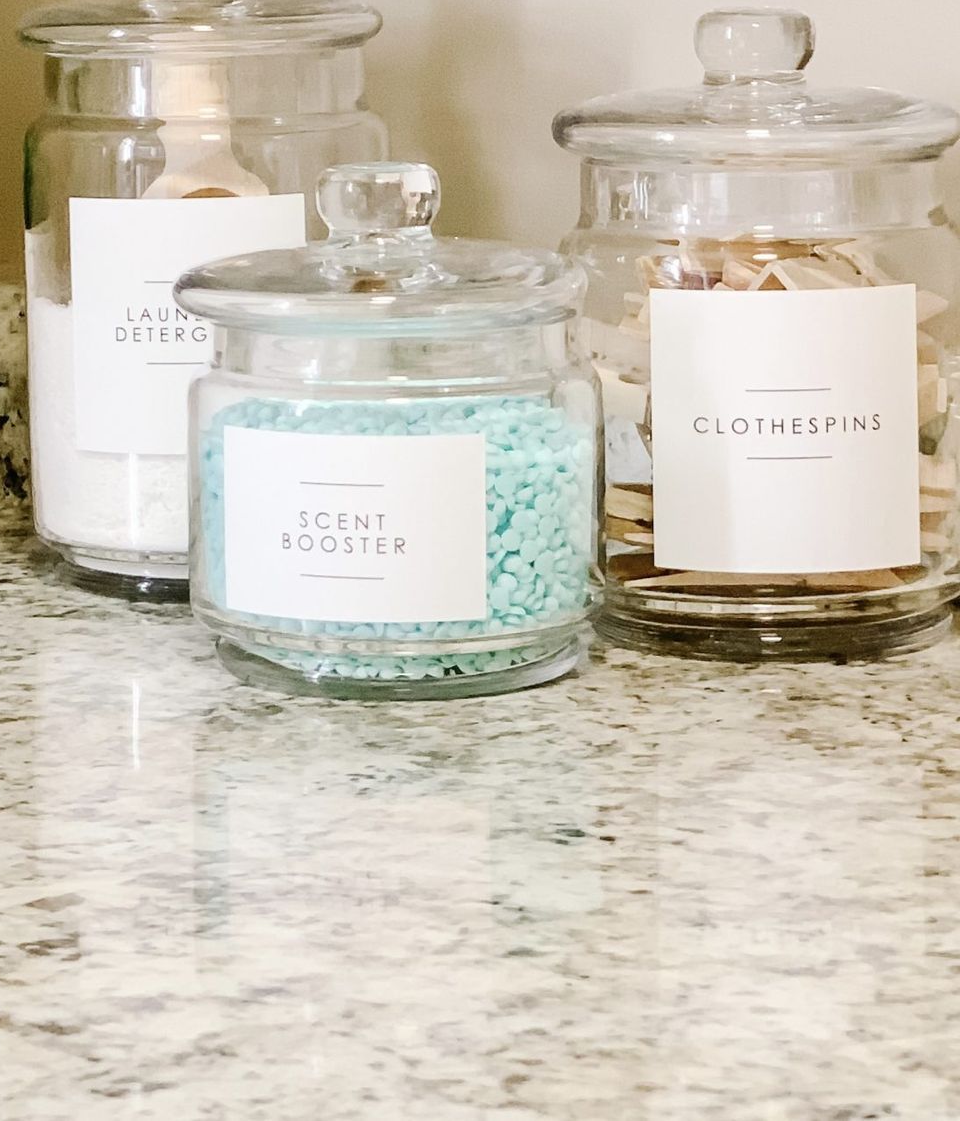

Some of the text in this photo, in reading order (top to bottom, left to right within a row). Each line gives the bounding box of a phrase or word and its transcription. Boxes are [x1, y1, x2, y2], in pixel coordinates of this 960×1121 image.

[693, 413, 881, 435] CLOTHESPINS
[298, 510, 386, 531] SCENT
[281, 533, 407, 555] BOOSTER
